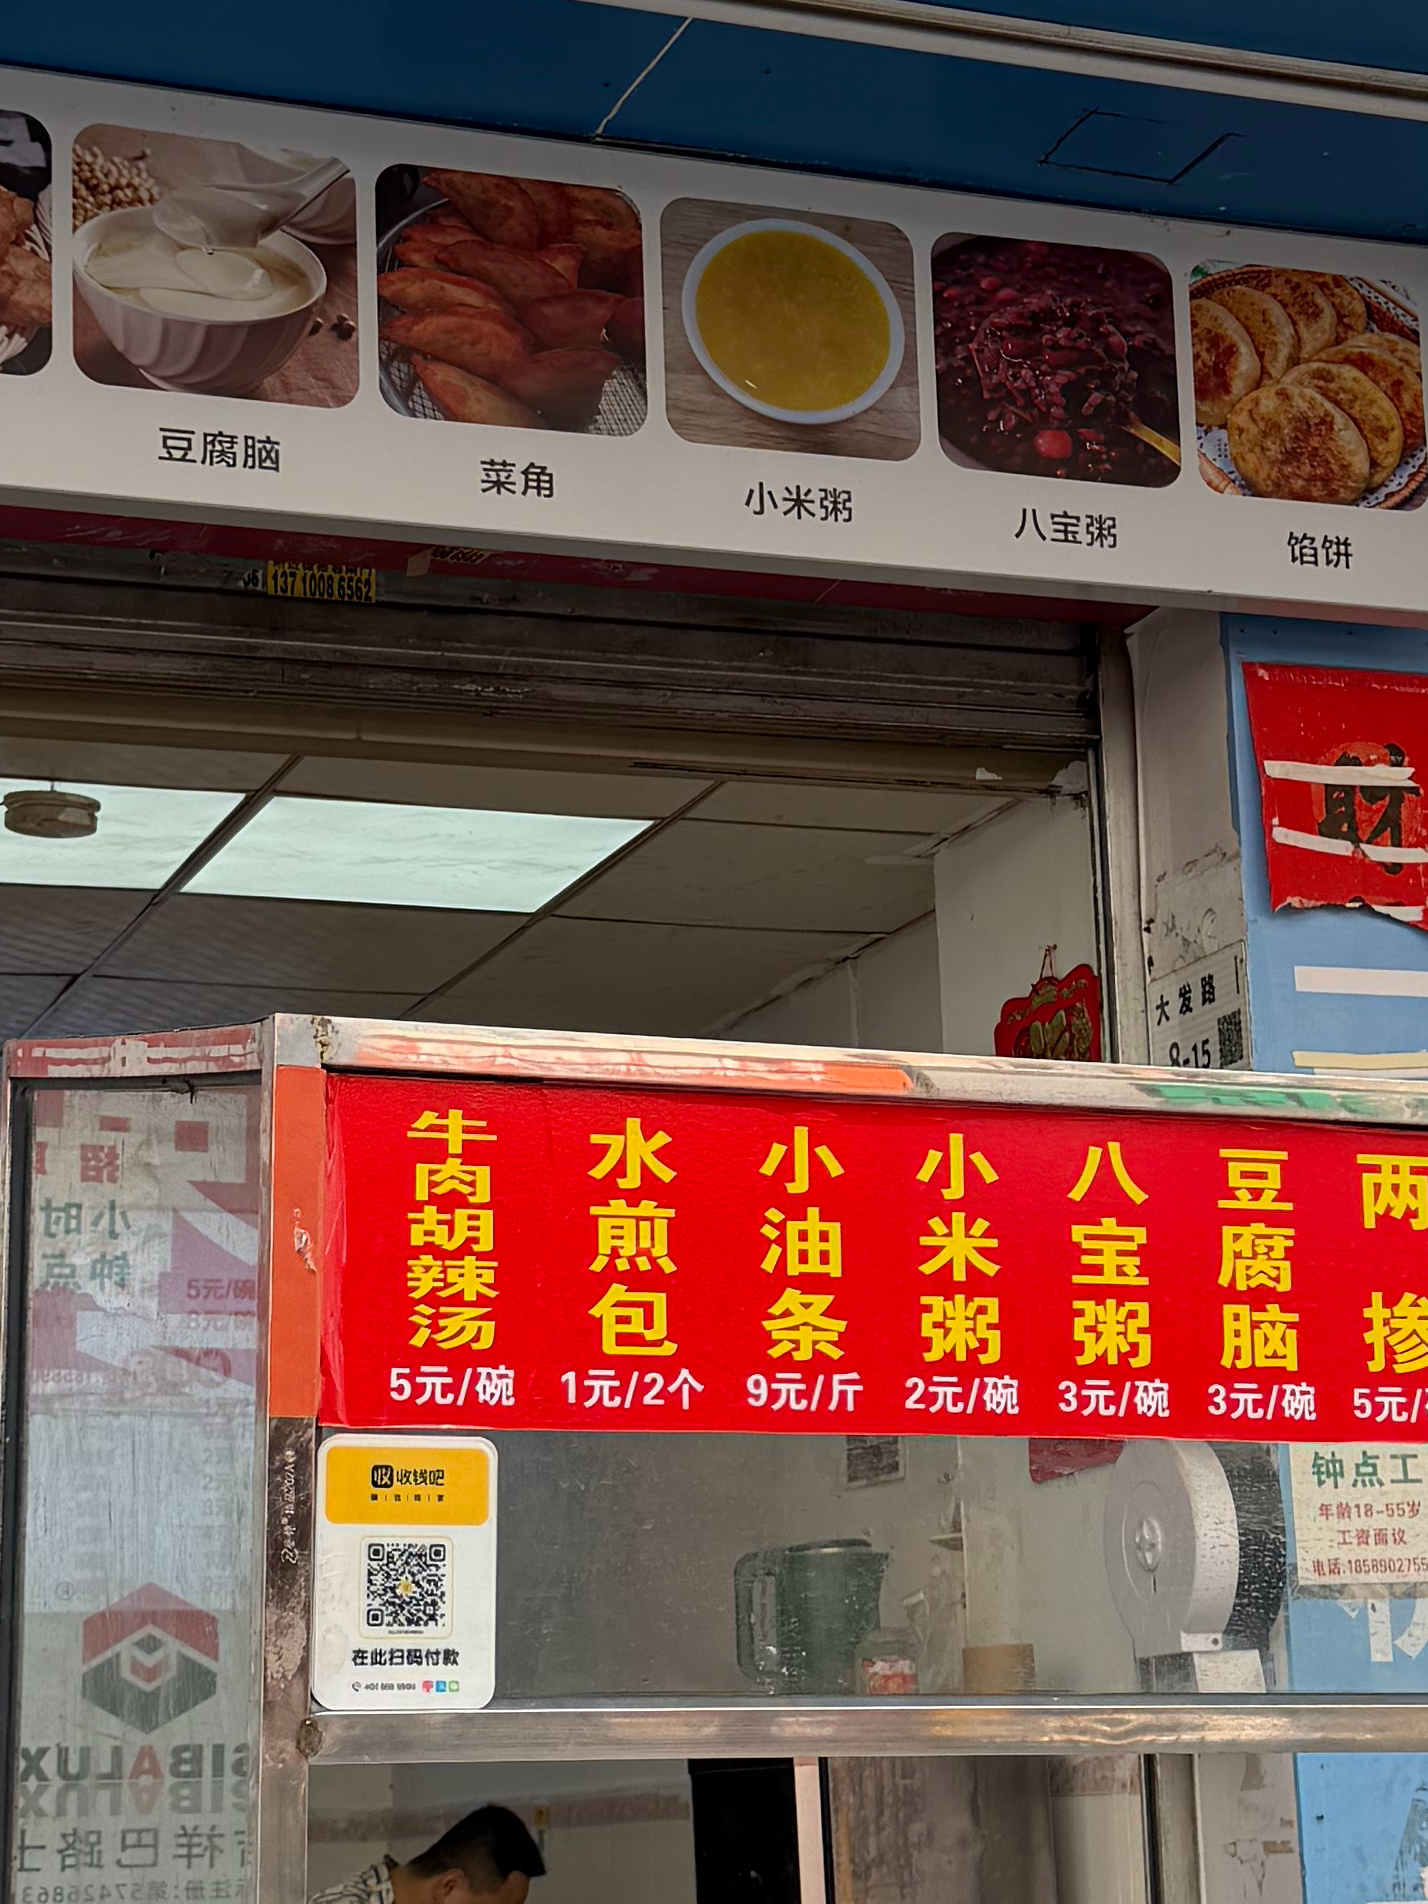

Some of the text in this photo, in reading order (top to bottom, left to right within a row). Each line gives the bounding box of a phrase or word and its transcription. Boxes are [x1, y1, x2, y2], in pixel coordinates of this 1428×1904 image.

[157, 427, 282, 475] 豆腐脑
[478, 457, 556, 500] 菜角
[744, 480, 854, 525] 小米粥
[1013, 506, 1118, 552] 八宝粥
[1286, 530, 1354, 571] 馅饼
[1155, 973, 1216, 1026] 大发路
[406, 1109, 499, 1351] 牛肉胡辣汤
[587, 1116, 678, 1357] 水煎包
[758, 1125, 849, 1362] 小油条
[915, 1132, 1002, 1366] 小米粥
[1066, 1140, 1152, 1370] 八宝粥
[1217, 1147, 1300, 1372] 豆腐脑
[389, 1364, 515, 1408] 5元/碗
[562, 1369, 704, 1410] 1元/2个
[745, 1372, 864, 1413] 9元/斤
[904, 1375, 1020, 1415] 2元/碗
[1058, 1378, 1170, 1420] 3元/碗
[1207, 1382, 1316, 1423] 3元/碗
[1311, 1451, 1423, 1489] 钟点工
[1318, 1500, 1421, 1521] 年龄18-55岁
[1336, 1528, 1407, 1546] 工资面议
[351, 1648, 459, 1666] 在此扫码付款
